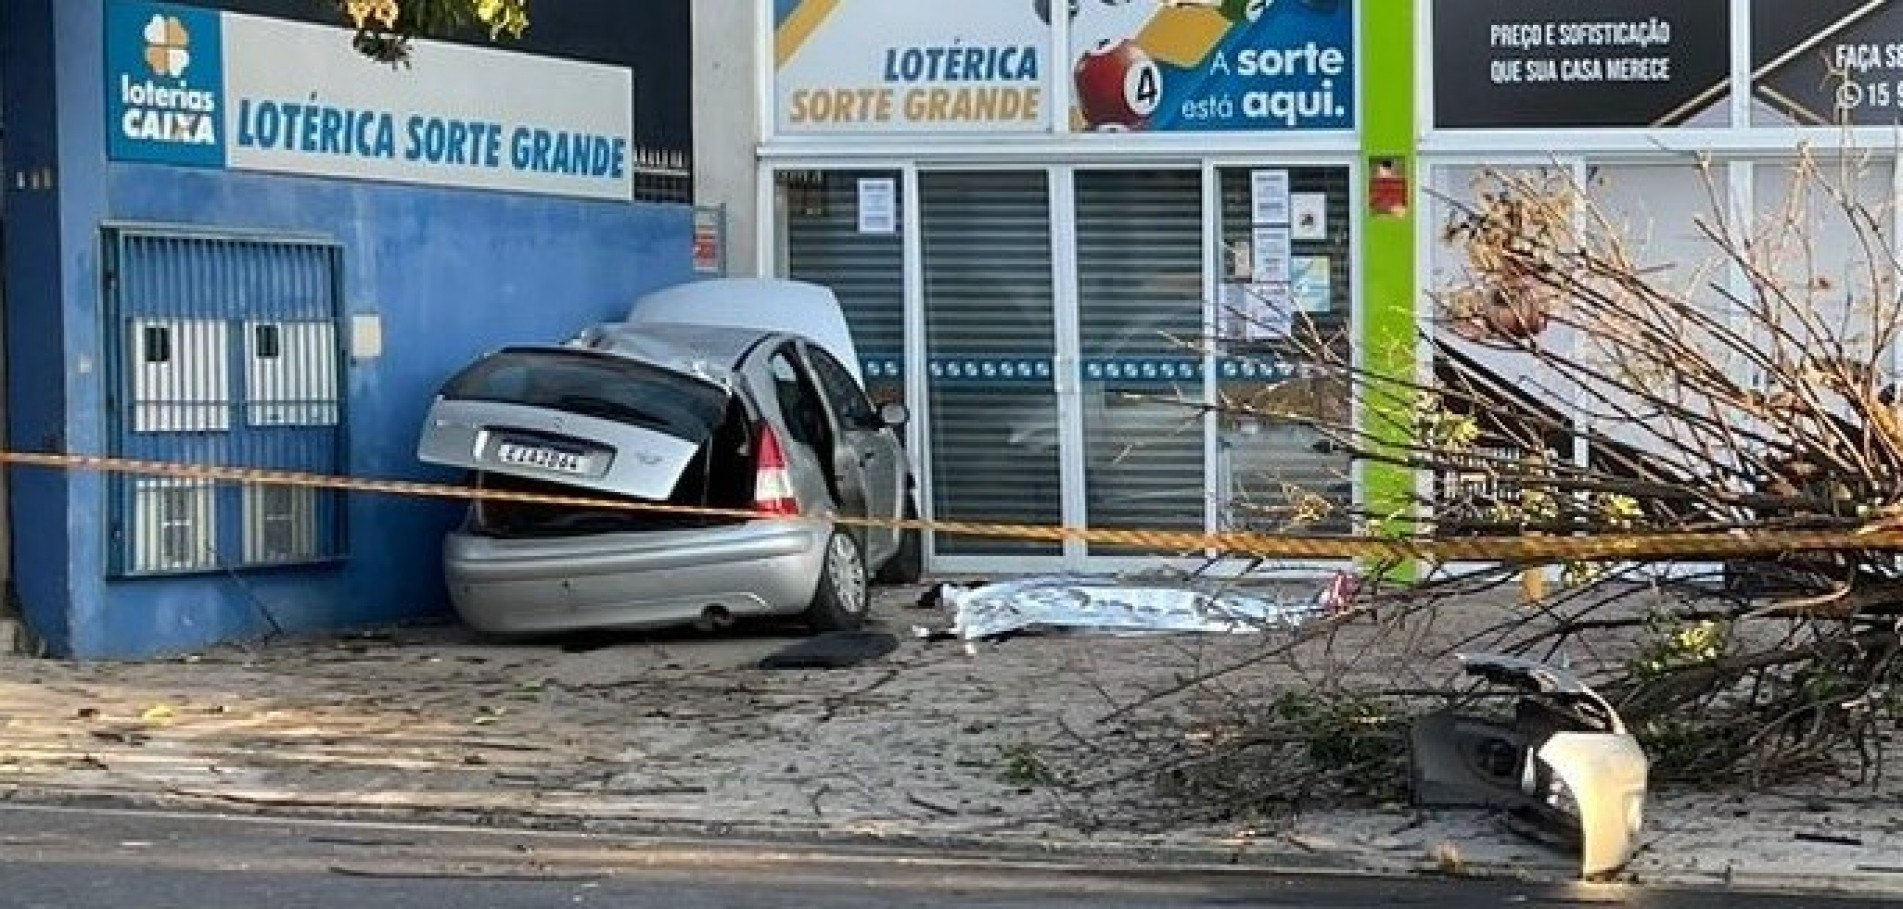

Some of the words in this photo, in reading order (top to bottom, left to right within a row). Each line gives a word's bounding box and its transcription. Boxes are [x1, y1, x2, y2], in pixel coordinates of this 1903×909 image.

[1490, 24, 1541, 49] PREÇO
[1546, 23, 1556, 45] E
[1559, 18, 1670, 48] SOFISTICAÇÃO
[885, 37, 1038, 82] LOTÉRICA
[1209, 51, 1231, 76] A
[1237, 42, 1343, 76] sorte
[1490, 61, 1523, 83] QUE
[1528, 60, 1558, 81] SUA
[1561, 59, 1602, 80] CASA
[1607, 58, 1670, 80] MERECE
[1836, 44, 1881, 73] FAÇA
[121, 73, 214, 111] loterias
[1137, 67, 1157, 104] 4
[1182, 95, 1233, 119] está
[1243, 79, 1346, 126] aqui.
[1867, 83, 1889, 106] 15
[791, 89, 892, 122] SORTE
[904, 87, 1041, 122] GRANDE
[122, 108, 215, 145] CAIXA
[237, 90, 396, 158] LOTÉRICA
[405, 115, 501, 166] SORTE
[511, 126, 625, 178] GRANDE
